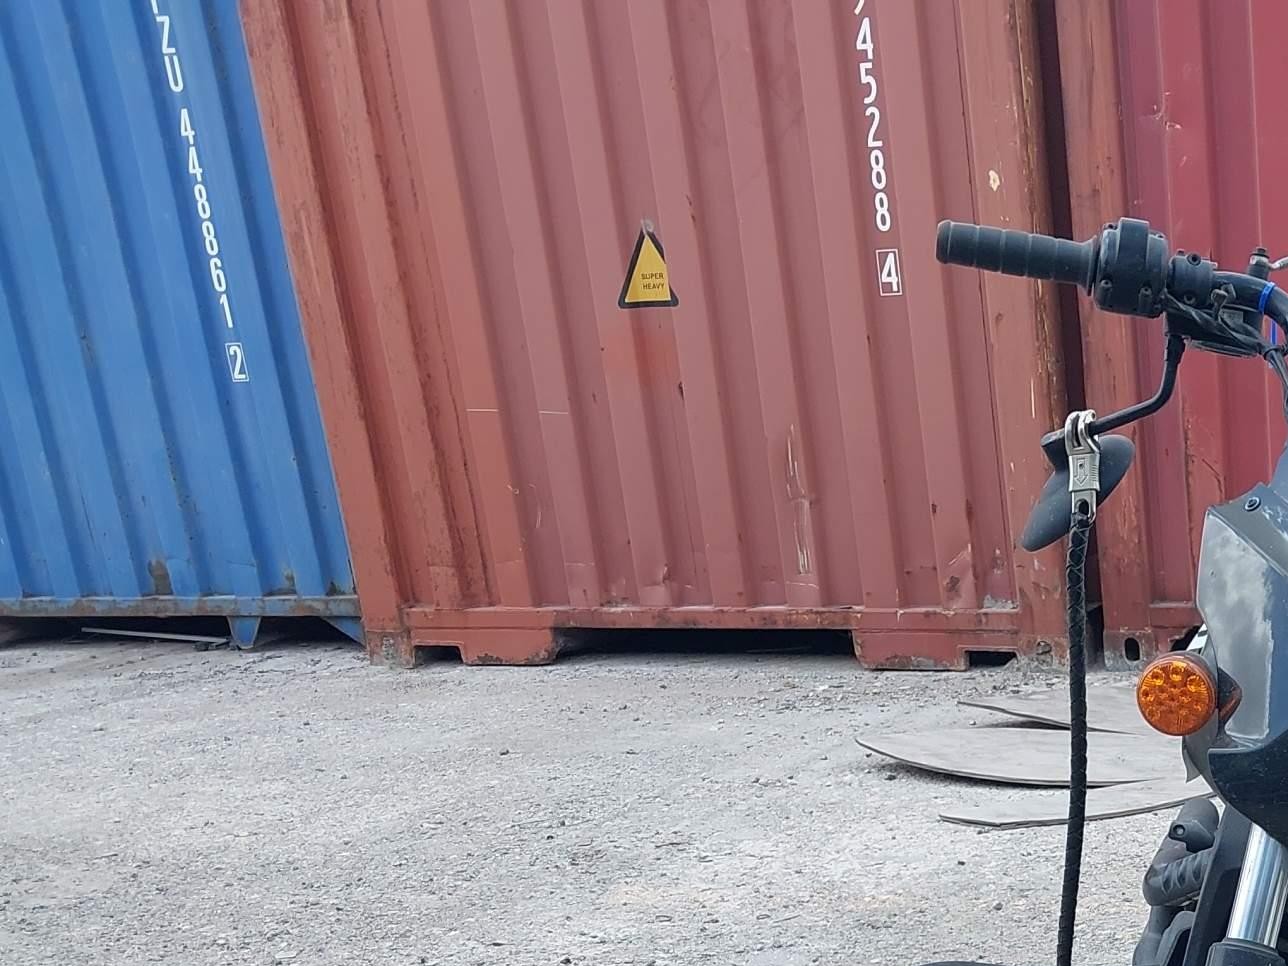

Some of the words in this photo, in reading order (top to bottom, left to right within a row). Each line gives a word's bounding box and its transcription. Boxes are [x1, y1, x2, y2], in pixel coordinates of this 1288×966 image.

[854, 0, 891, 231] 45288
[879, 251, 900, 294] 4
[180, 108, 233, 328] 448861
[228, 344, 248, 380] 2
[641, 272, 665, 280] SUPER
[642, 282, 665, 290] HEAVY
